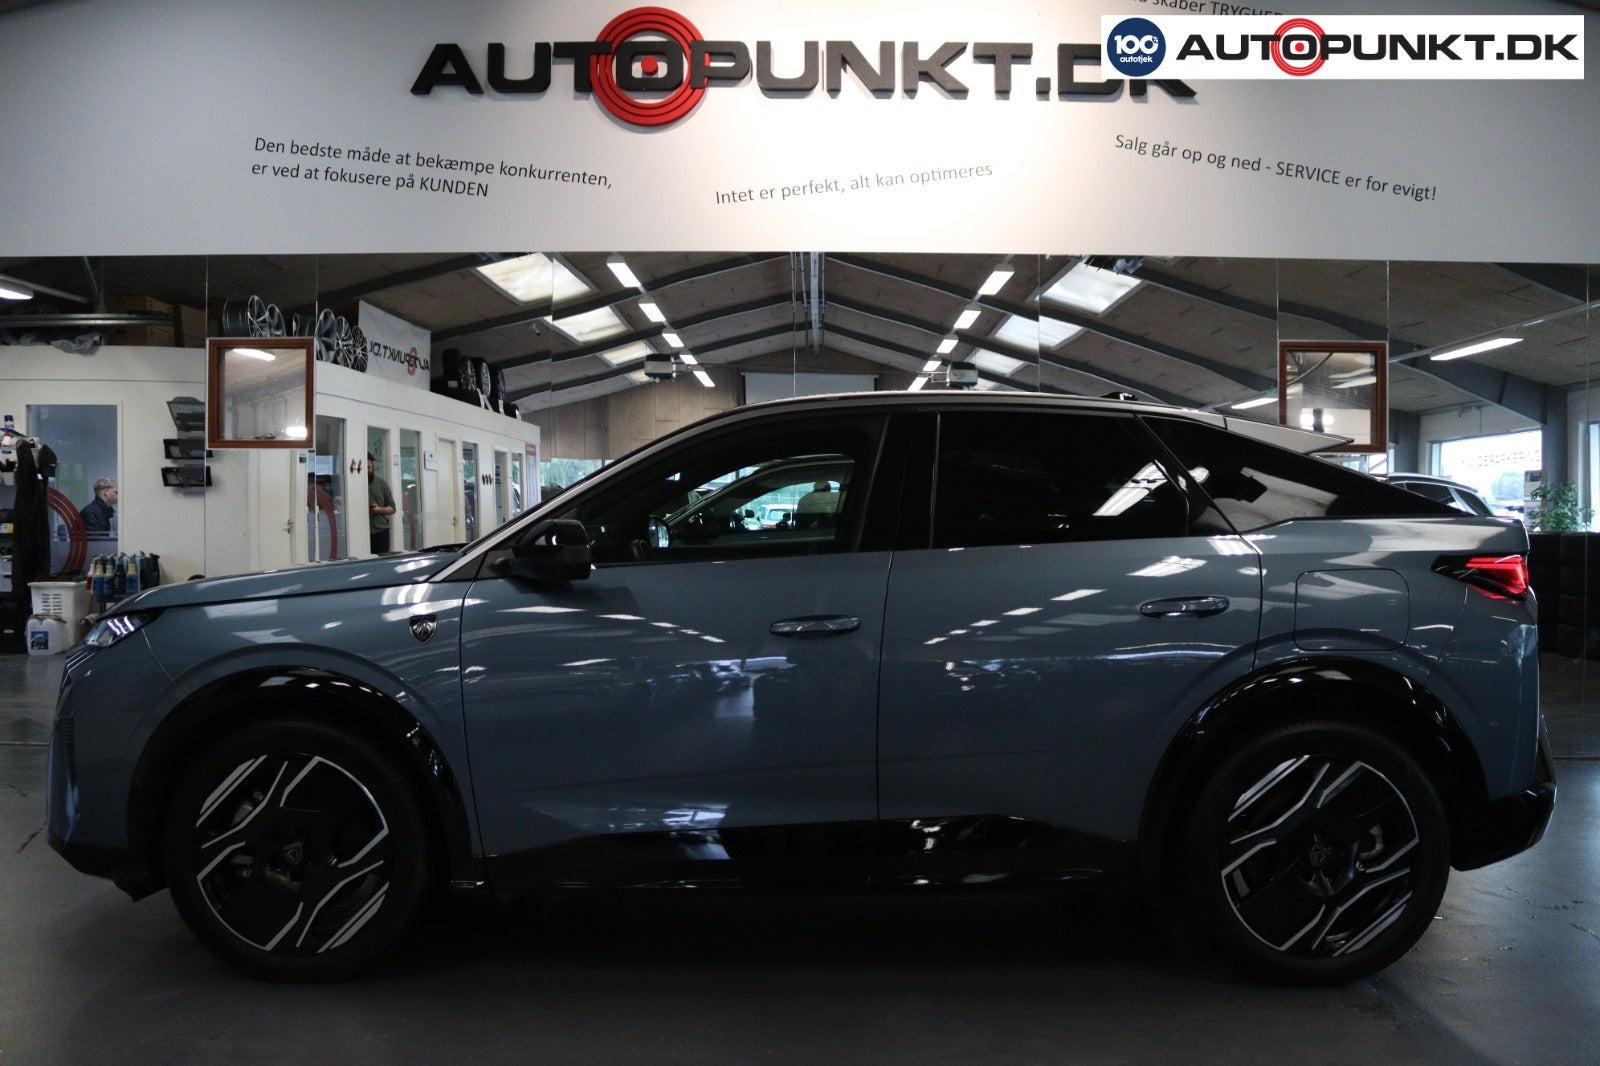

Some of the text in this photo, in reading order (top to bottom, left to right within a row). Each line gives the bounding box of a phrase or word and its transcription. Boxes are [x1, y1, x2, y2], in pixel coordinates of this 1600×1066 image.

[1211, 1, 1283, 15] TRYG
[252, 163, 489, 197] er ved at fokusere på KUNDEN
[255, 137, 612, 189] Den bedste måde at bekæmpe konkurrenten,
[1115, 134, 1148, 156] Salg
[1151, 140, 1178, 158] går
[1182, 148, 1202, 164] op
[1207, 153, 1226, 169] og
[1231, 157, 1261, 171] ned
[1275, 161, 1341, 185] SERVICE
[1345, 175, 1362, 188] er
[1366, 175, 1388, 192] for
[1392, 183, 1437, 202] evigt!
[716, 164, 993, 204] Intet er perfekt, alt kan optimeres
